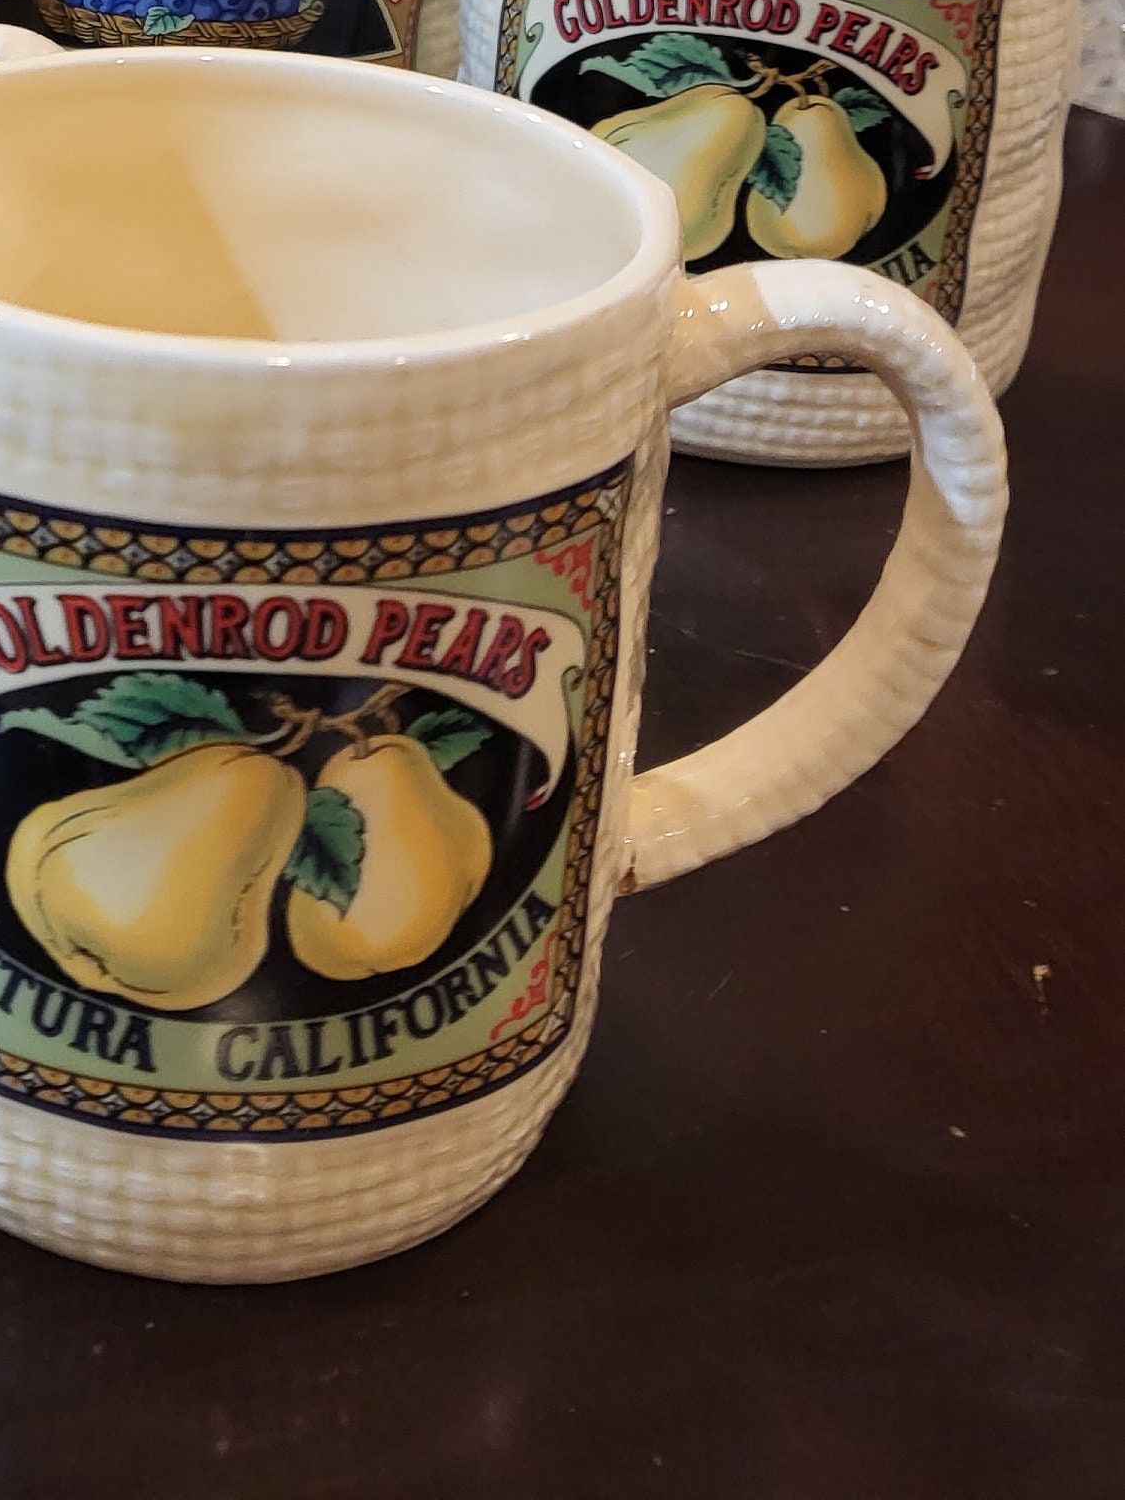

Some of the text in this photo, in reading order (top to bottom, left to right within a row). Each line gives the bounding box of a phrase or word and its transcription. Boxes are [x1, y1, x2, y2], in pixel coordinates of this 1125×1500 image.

[806, 2, 939, 96] PEARS
[360, 597, 553, 699] PEARS
[215, 890, 561, 1082] CALIFORNIA
